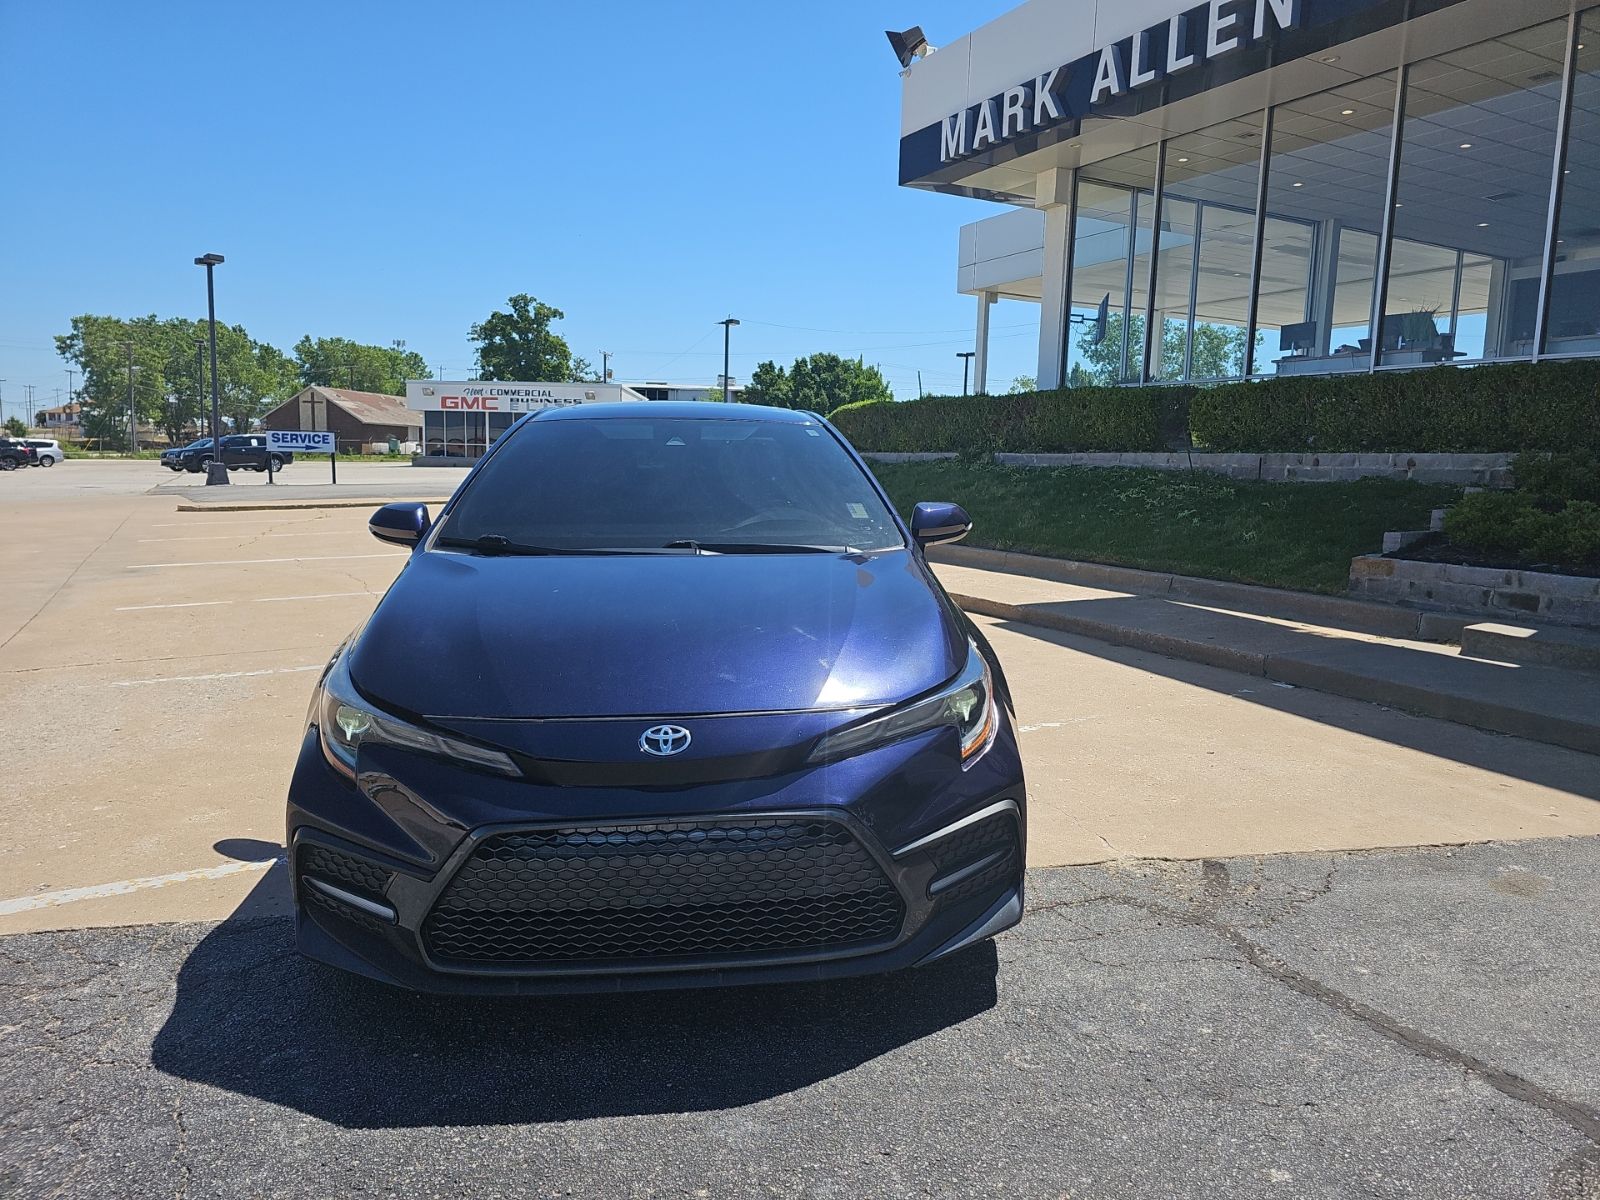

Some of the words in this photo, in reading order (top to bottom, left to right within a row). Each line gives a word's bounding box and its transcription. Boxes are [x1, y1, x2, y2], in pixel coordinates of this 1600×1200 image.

[940, 67, 1066, 162] MARK
[1090, 0, 1297, 103] ALLEN
[490, 388, 554, 397] COMMERCIAL
[440, 396, 499, 410] GMC
[271, 432, 330, 444] SERVICE
